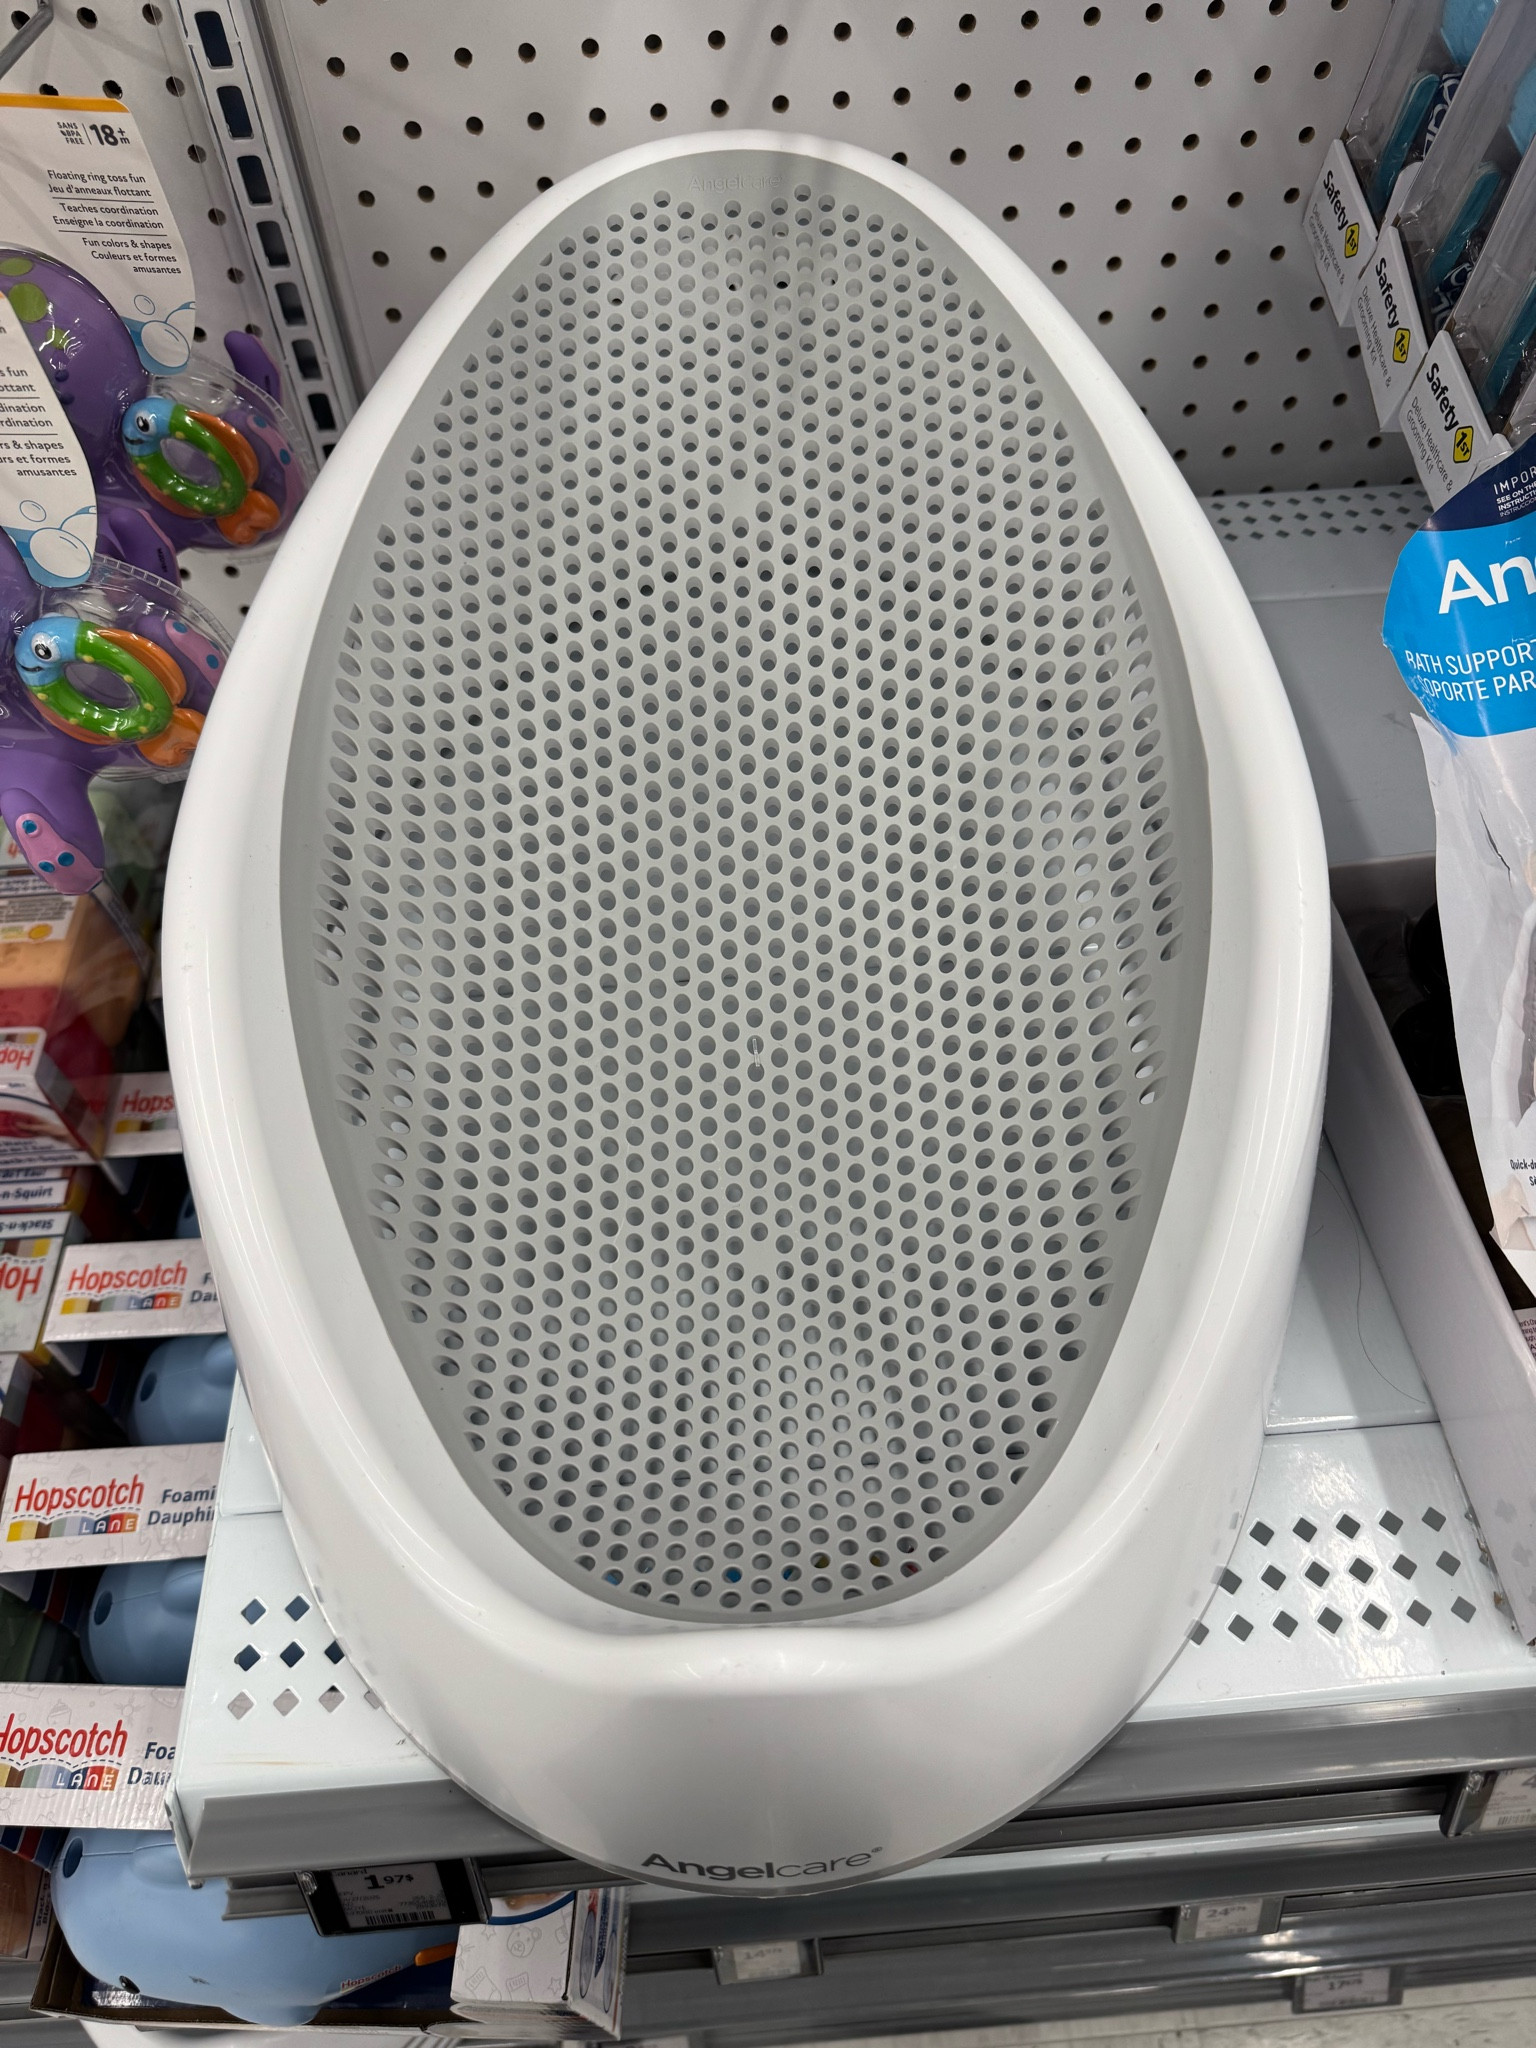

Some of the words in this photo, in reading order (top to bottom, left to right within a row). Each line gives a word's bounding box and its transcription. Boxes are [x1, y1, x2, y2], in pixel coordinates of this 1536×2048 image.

[57, 121, 78, 130] SANS
[65, 137, 85, 145] FREE
[47, 169, 88, 184] Floating
[88, 171, 106, 185] ring
[107, 173, 128, 183] toss
[129, 173, 146, 183] fun
[48, 184, 65, 194] Jeu
[66, 184, 113, 196] d'anneaux
[114, 186, 152, 197] flottant
[1323, 170, 1349, 231] Safety
[59, 203, 98, 214] Teaches
[99, 204, 159, 216] coordination
[53, 216, 94, 229] Enseigne
[95, 217, 104, 227] la
[105, 218, 164, 229] coordination
[82, 237, 100, 247] Fun
[101, 239, 129, 249] colors
[130, 239, 139, 249] &
[140, 240, 172, 252] shapes
[91, 250, 131, 261] Couleurs
[132, 253, 143, 262] et
[144, 252, 177, 263] formes
[133, 265, 182, 275] amusantes
[1376, 257, 1399, 329] Safety
[1357, 296, 1373, 350] Grooming
[1362, 285, 1374, 322] Deluxe
[1370, 321, 1388, 377] Healthcare
[6, 366, 28, 377] fun
[1426, 362, 1459, 432] Safety
[12, 440, 24, 450] &
[25, 440, 64, 452] shapes
[1406, 409, 1427, 461] Grooming
[1424, 456, 1435, 475] Kit
[1411, 396, 1427, 431] Deluxe
[1424, 428, 1449, 482] Healthcare
[1446, 479, 1454, 493] &
[16, 455, 29, 463] et
[29, 453, 71, 464] formes
[17, 467, 77, 476] amusantes
[1496, 494, 1511, 504] SEE
[1512, 489, 1524, 498] ON
[67, 1260, 188, 1293] Hopscotch
[14, 1474, 145, 1516] Hopscotch
[161, 1485, 216, 1504] Foami
[341, 1963, 403, 1990] Hopscotch
